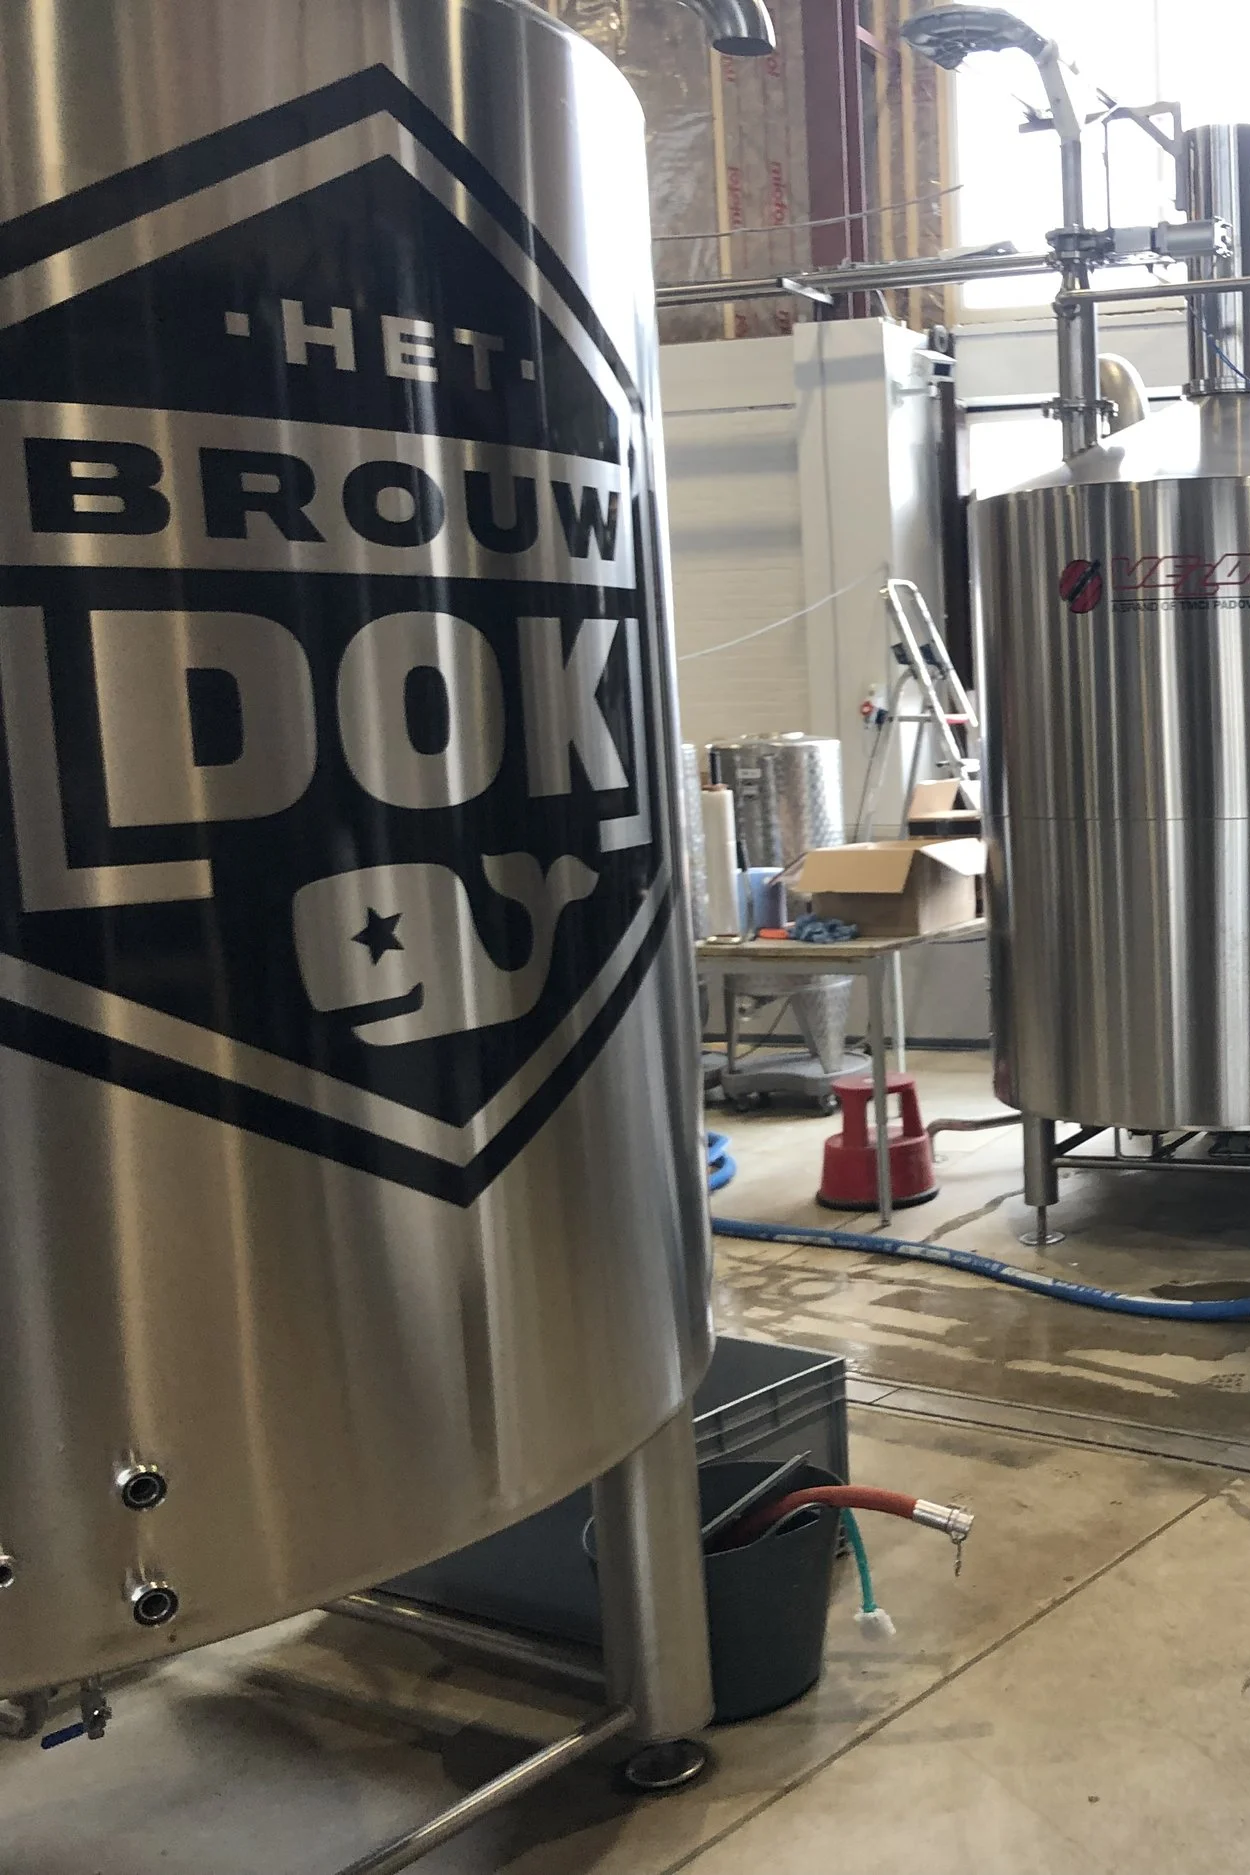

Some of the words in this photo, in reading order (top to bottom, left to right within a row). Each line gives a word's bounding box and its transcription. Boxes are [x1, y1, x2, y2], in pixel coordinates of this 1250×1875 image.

[24, 436, 621, 561] BROUW
[1161, 602, 1176, 612] OF
[90, 607, 630, 828] DOK
